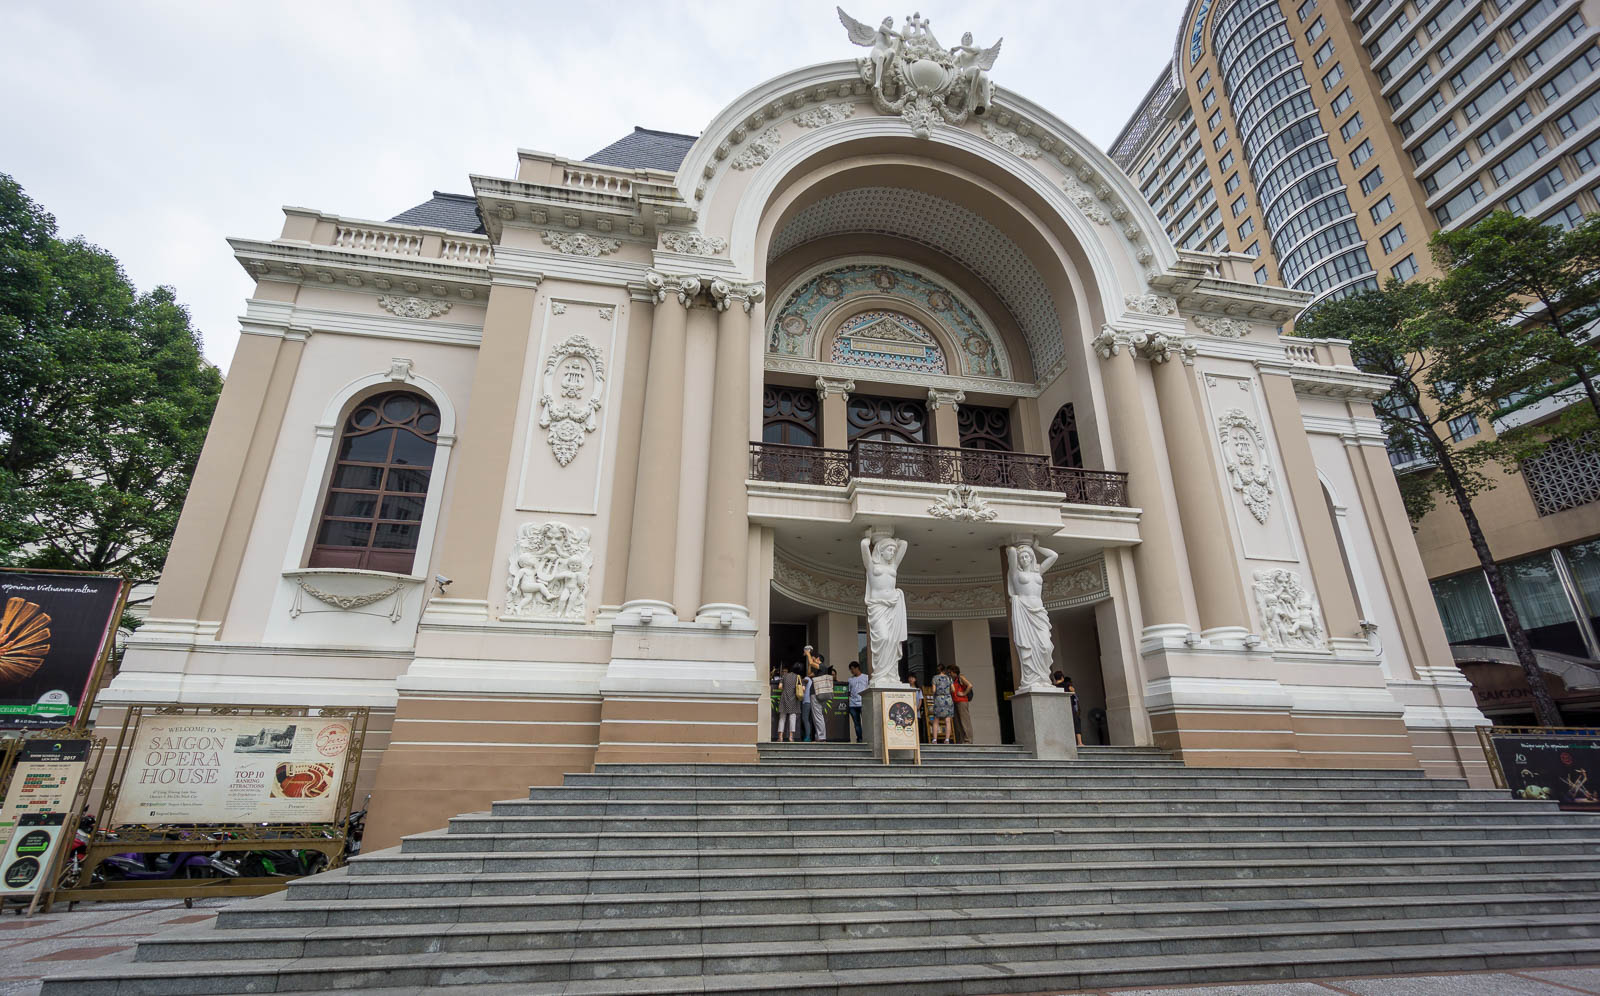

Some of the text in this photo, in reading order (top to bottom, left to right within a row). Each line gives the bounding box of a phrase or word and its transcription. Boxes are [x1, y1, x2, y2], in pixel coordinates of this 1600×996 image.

[1191, 0, 1212, 63] CARAV
[149, 736, 226, 751] SAIGON
[145, 751, 221, 767] OPERA
[138, 768, 219, 784] HOUSE
[235, 770, 265, 778] TOP 10
